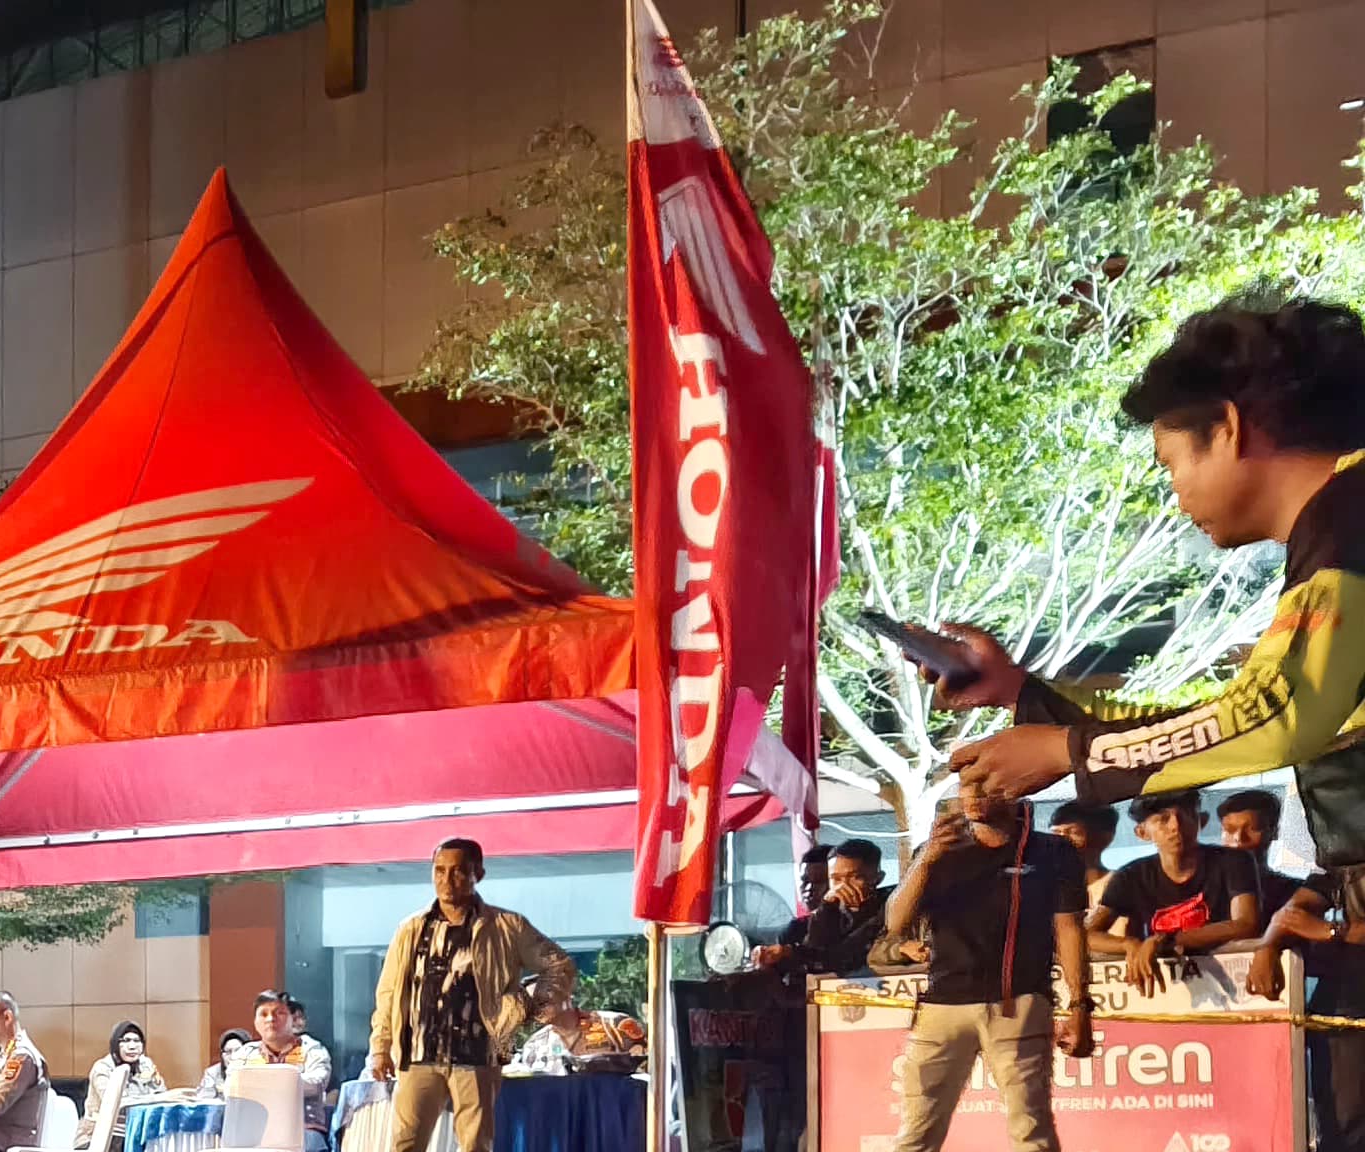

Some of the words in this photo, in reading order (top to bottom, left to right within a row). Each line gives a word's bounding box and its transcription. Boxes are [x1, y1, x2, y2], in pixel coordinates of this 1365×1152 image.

[658, 332, 729, 887] HONDA
[1110, 1095, 1151, 1109] ADA
[1154, 1094, 1173, 1108] DI
[1177, 1093, 1214, 1107] SINI
